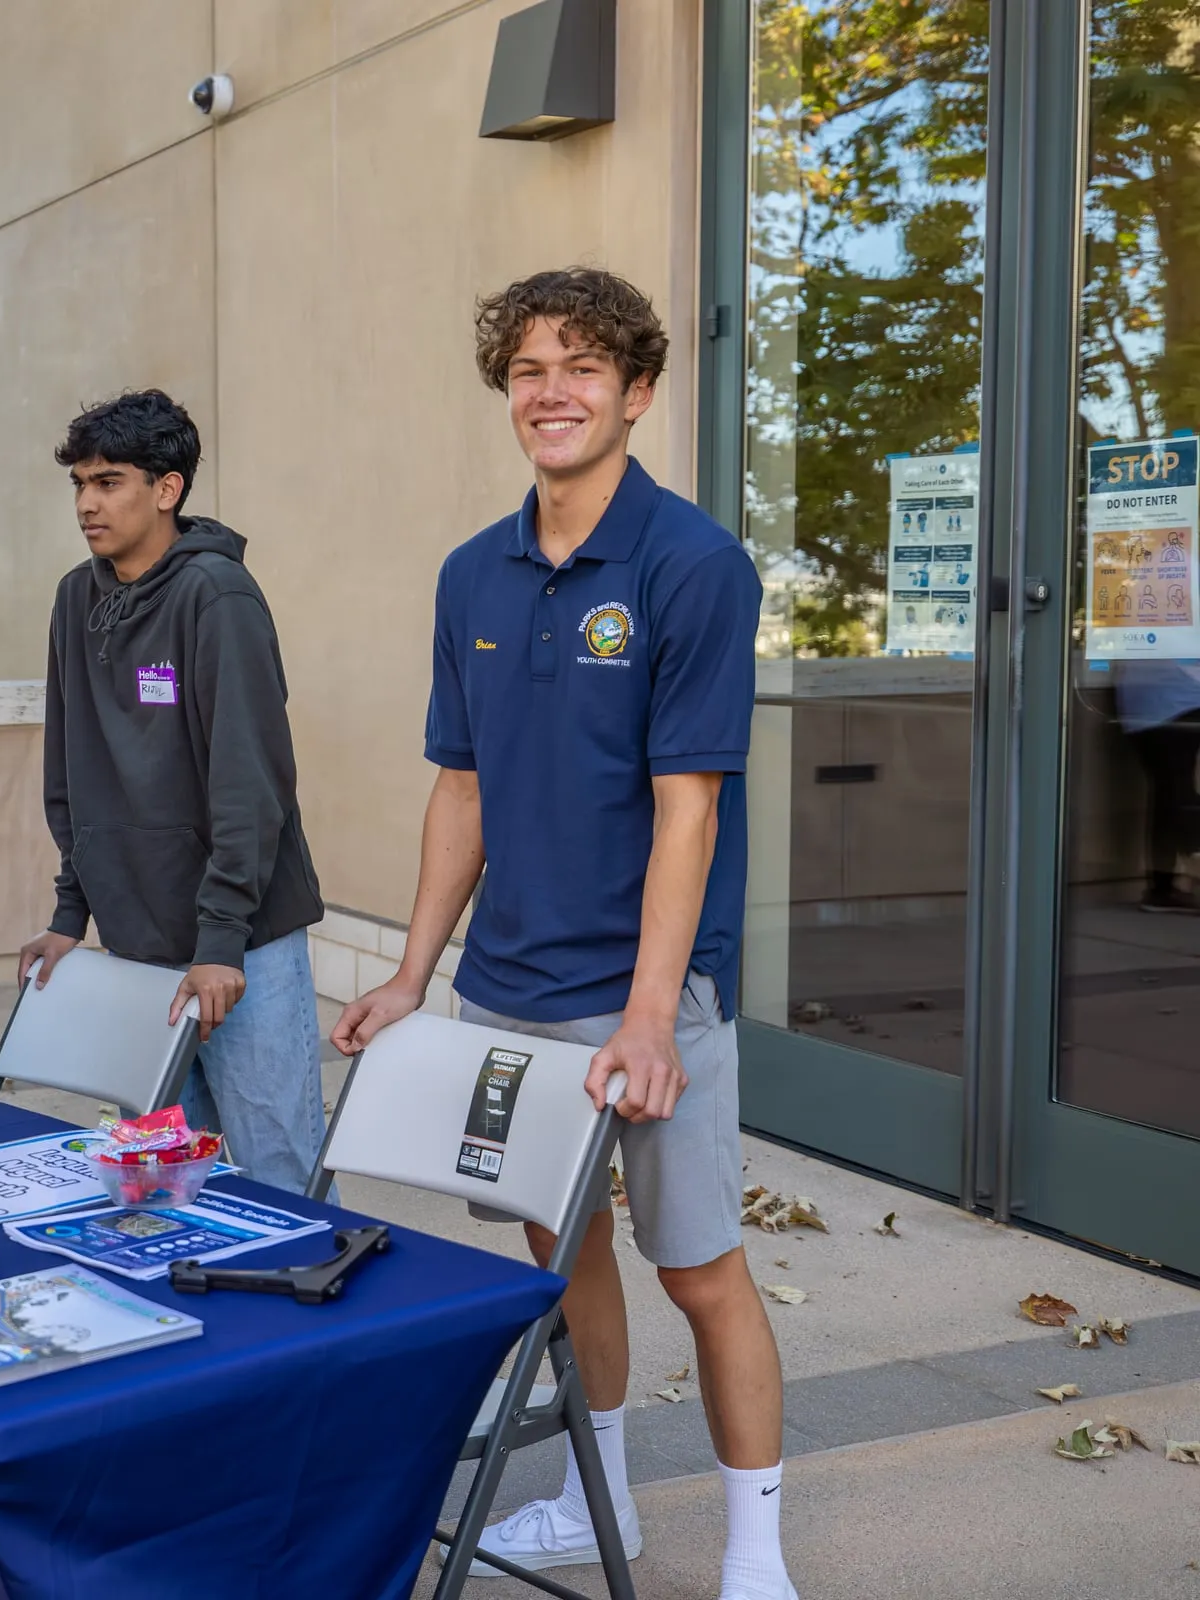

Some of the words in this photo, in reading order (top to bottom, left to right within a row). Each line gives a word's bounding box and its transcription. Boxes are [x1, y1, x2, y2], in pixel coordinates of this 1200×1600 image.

[1108, 452, 1179, 484] STOP
[1107, 500, 1120, 509] DO
[1123, 497, 1143, 508] NOT
[1145, 494, 1178, 506] ENTER
[578, 608, 597, 632] PARKS
[597, 602, 609, 611] and
[609, 601, 635, 636] RECREATION
[475, 638, 497, 649] Brian
[576, 655, 597, 664] YOUTH
[597, 657, 631, 667] COMMITTEE
[488, 1076, 511, 1088] CHAIR
